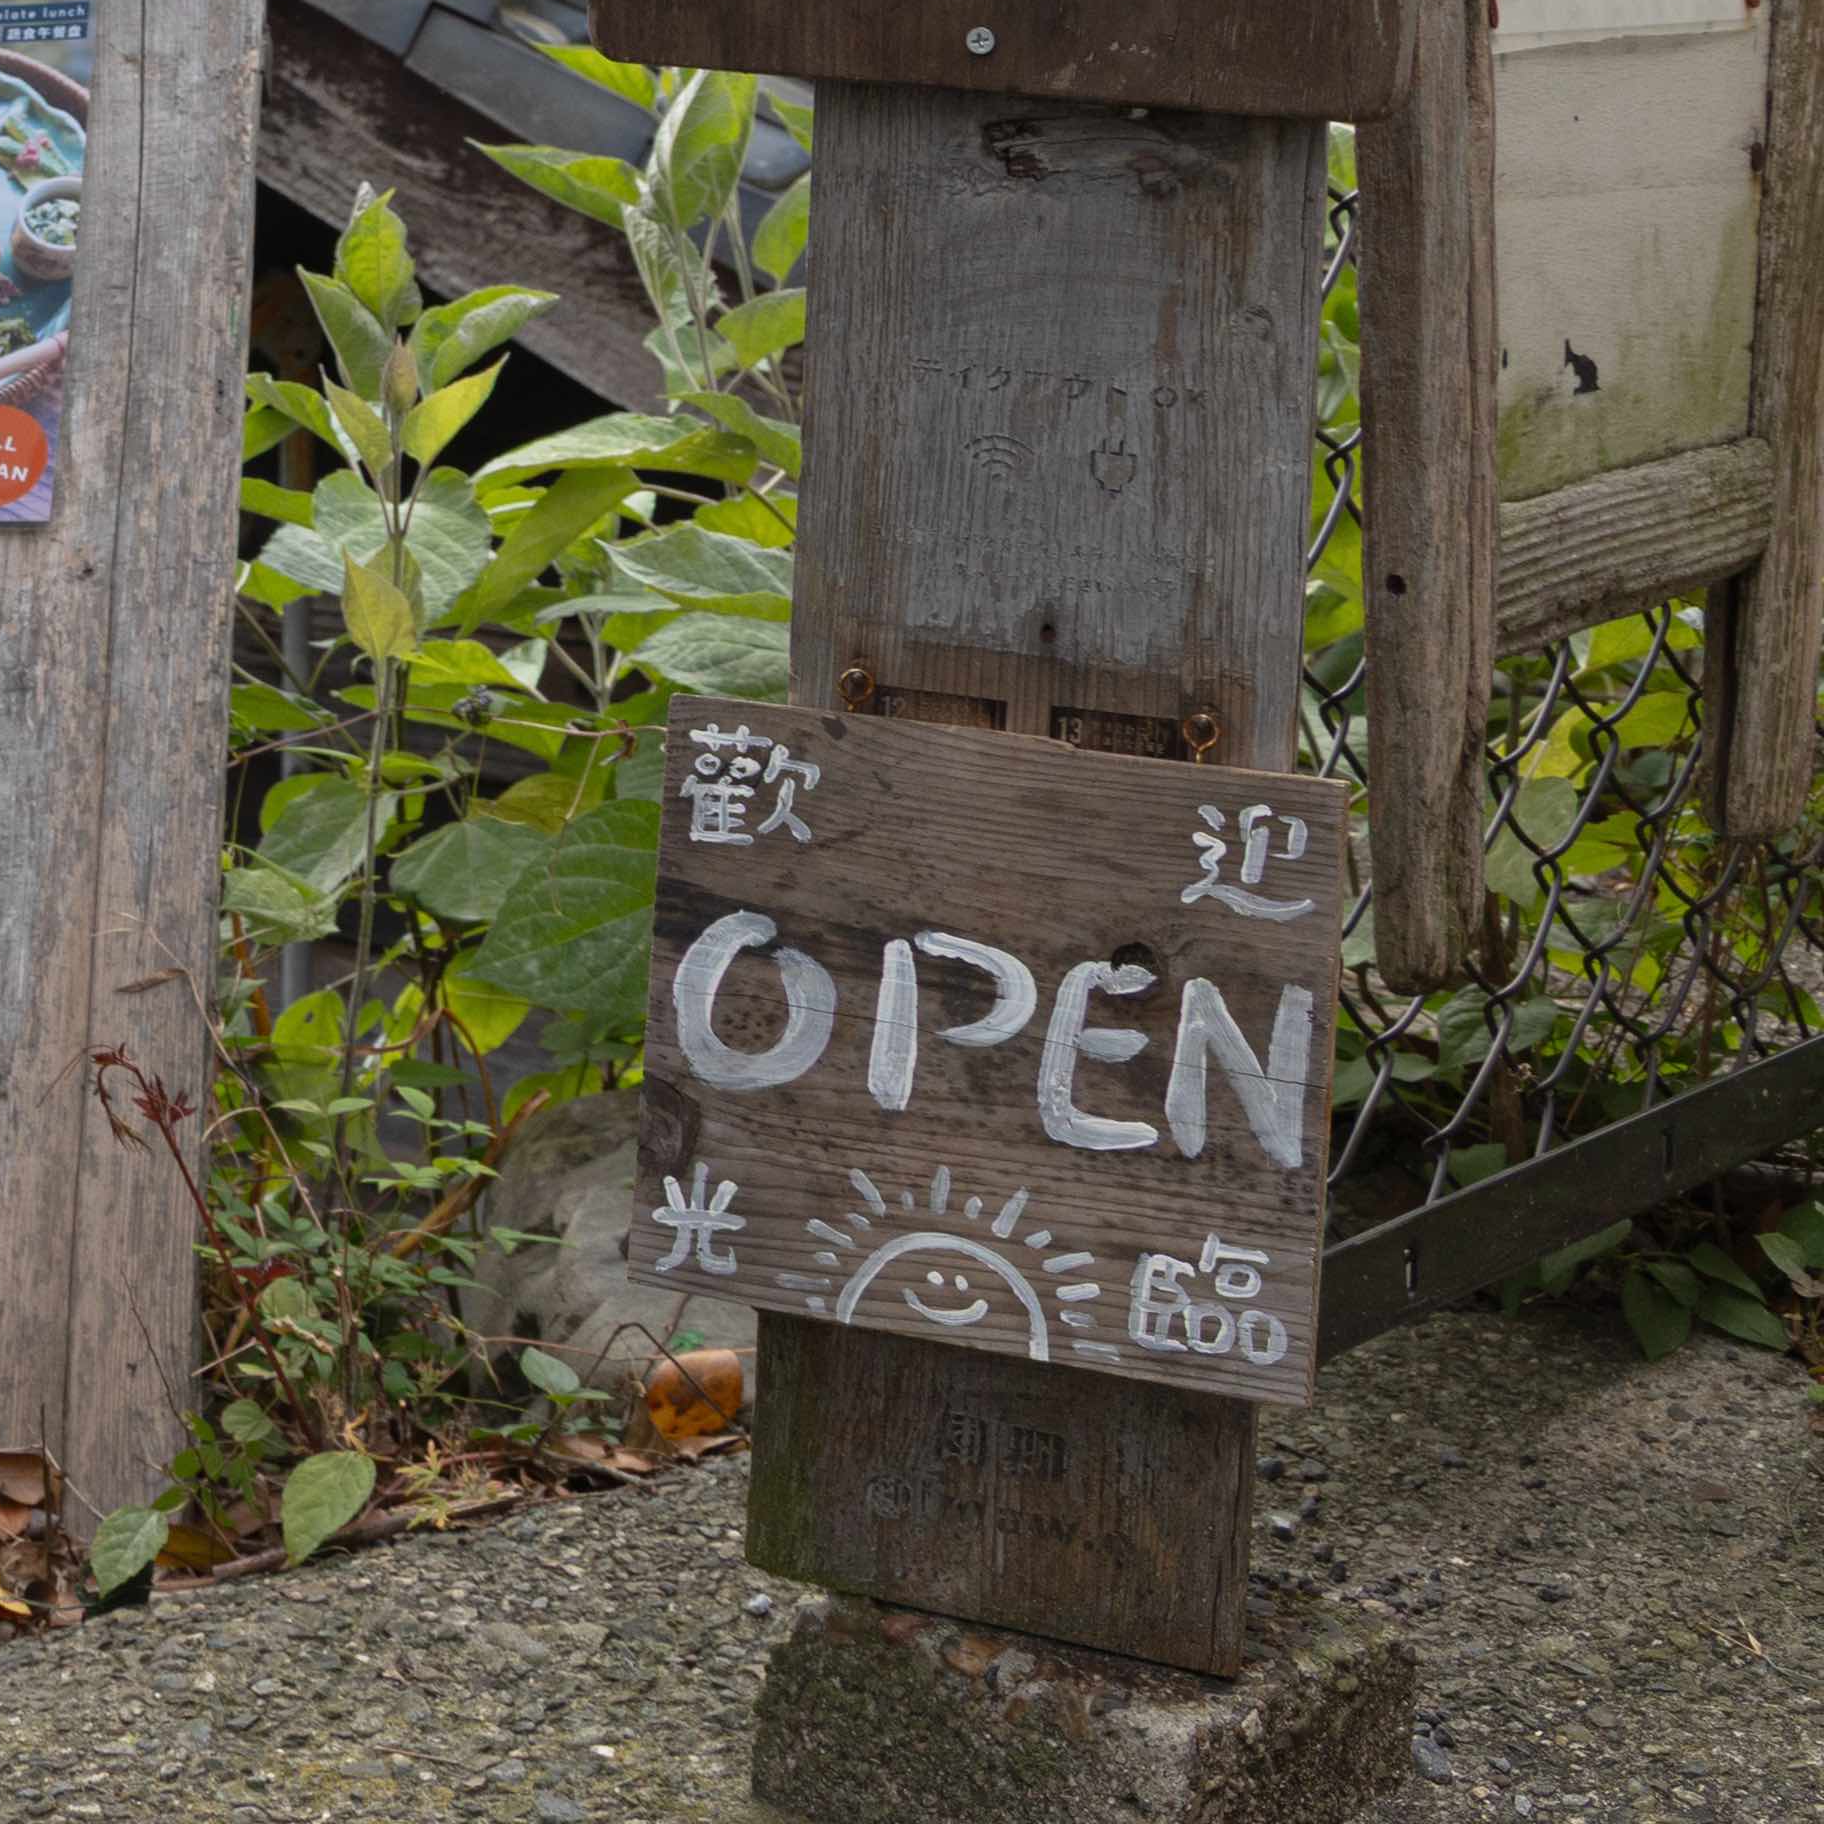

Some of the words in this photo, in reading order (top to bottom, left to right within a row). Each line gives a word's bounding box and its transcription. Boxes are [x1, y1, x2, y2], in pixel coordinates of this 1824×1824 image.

[42, 4, 87, 21] lunch
[1179, 803, 1317, 922] 迎
[672, 907, 1316, 1170] OPEN
[651, 1159, 749, 1276] 光
